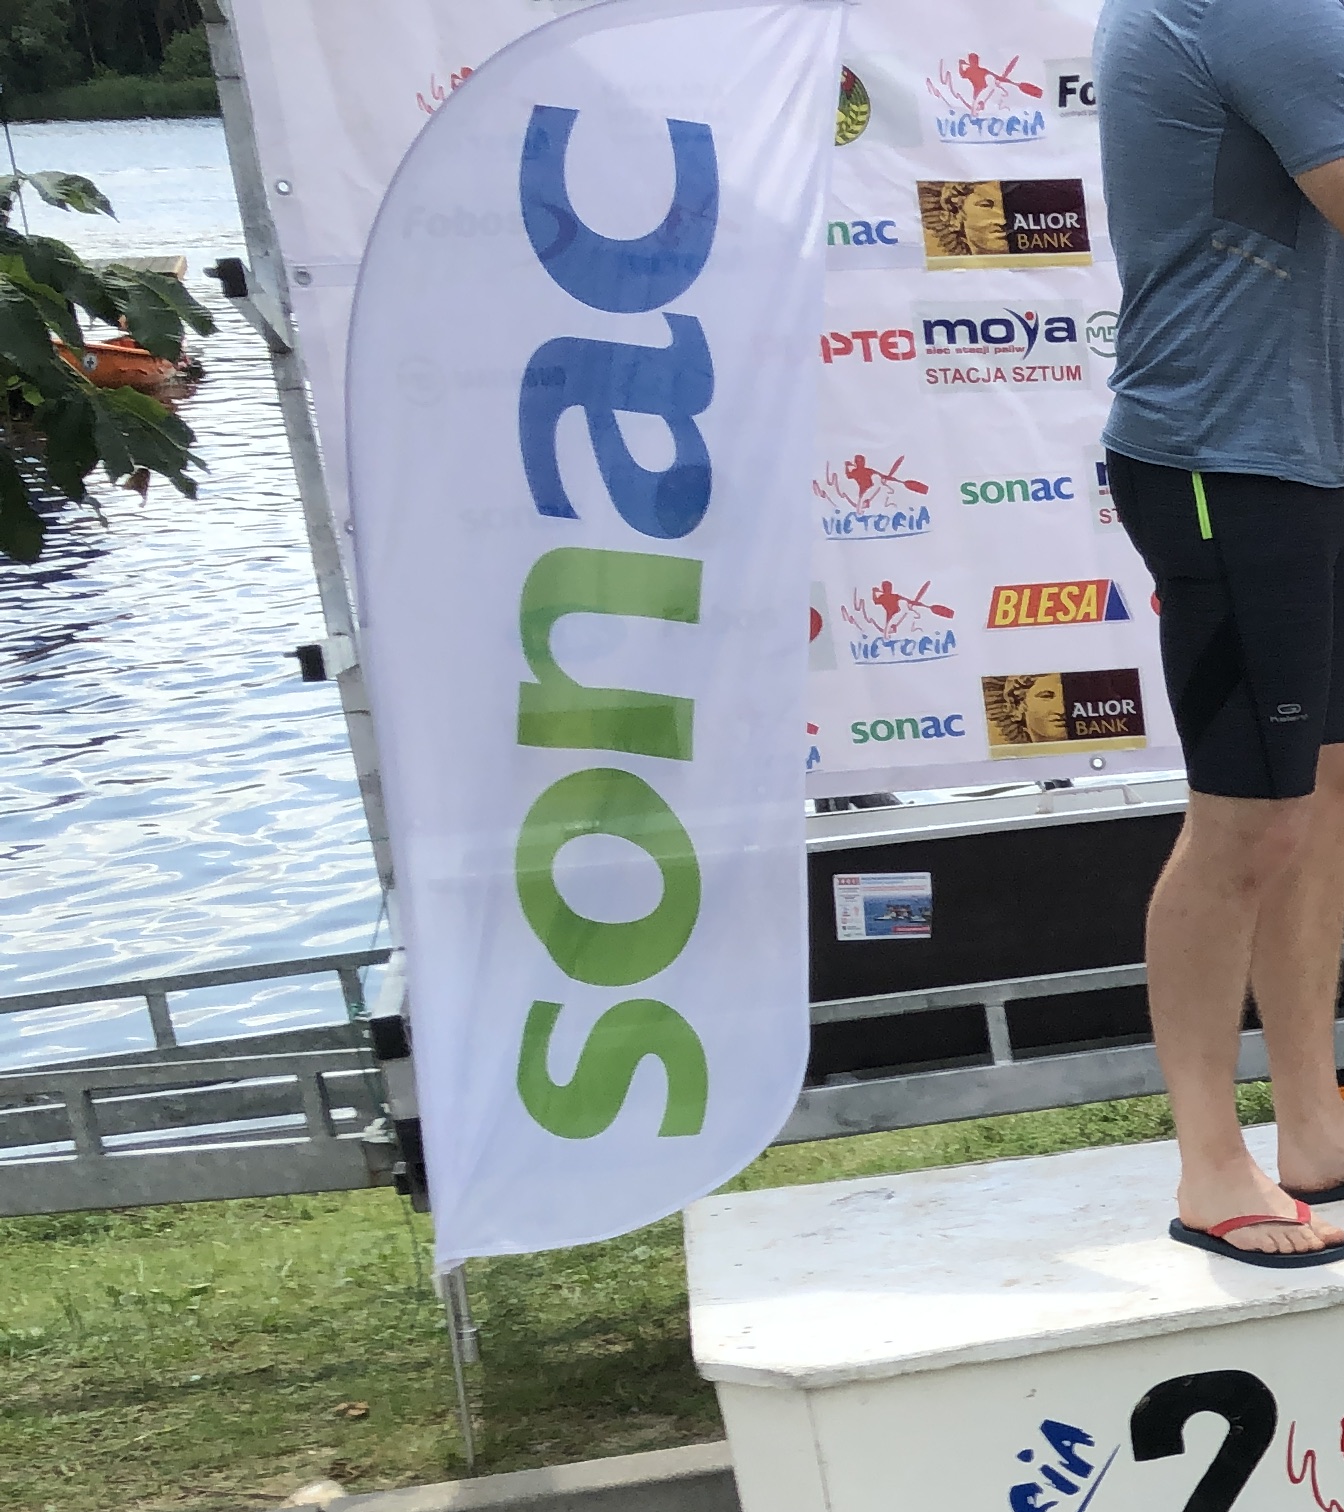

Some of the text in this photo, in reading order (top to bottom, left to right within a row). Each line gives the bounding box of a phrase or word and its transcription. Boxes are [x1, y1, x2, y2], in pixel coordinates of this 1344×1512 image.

[827, 220, 898, 246] nac
[1014, 213, 1080, 231] ALIOR
[1017, 234, 1073, 250] BANK
[922, 308, 1077, 359] moya
[926, 365, 1082, 385] STACJA SZTUM
[960, 476, 1075, 505] sonac
[994, 585, 1098, 626] BLESA
[515, 103, 721, 1141] sonac
[1071, 699, 1137, 720] ALIOR
[851, 714, 966, 744] sonac
[1075, 718, 1129, 736] BANK
